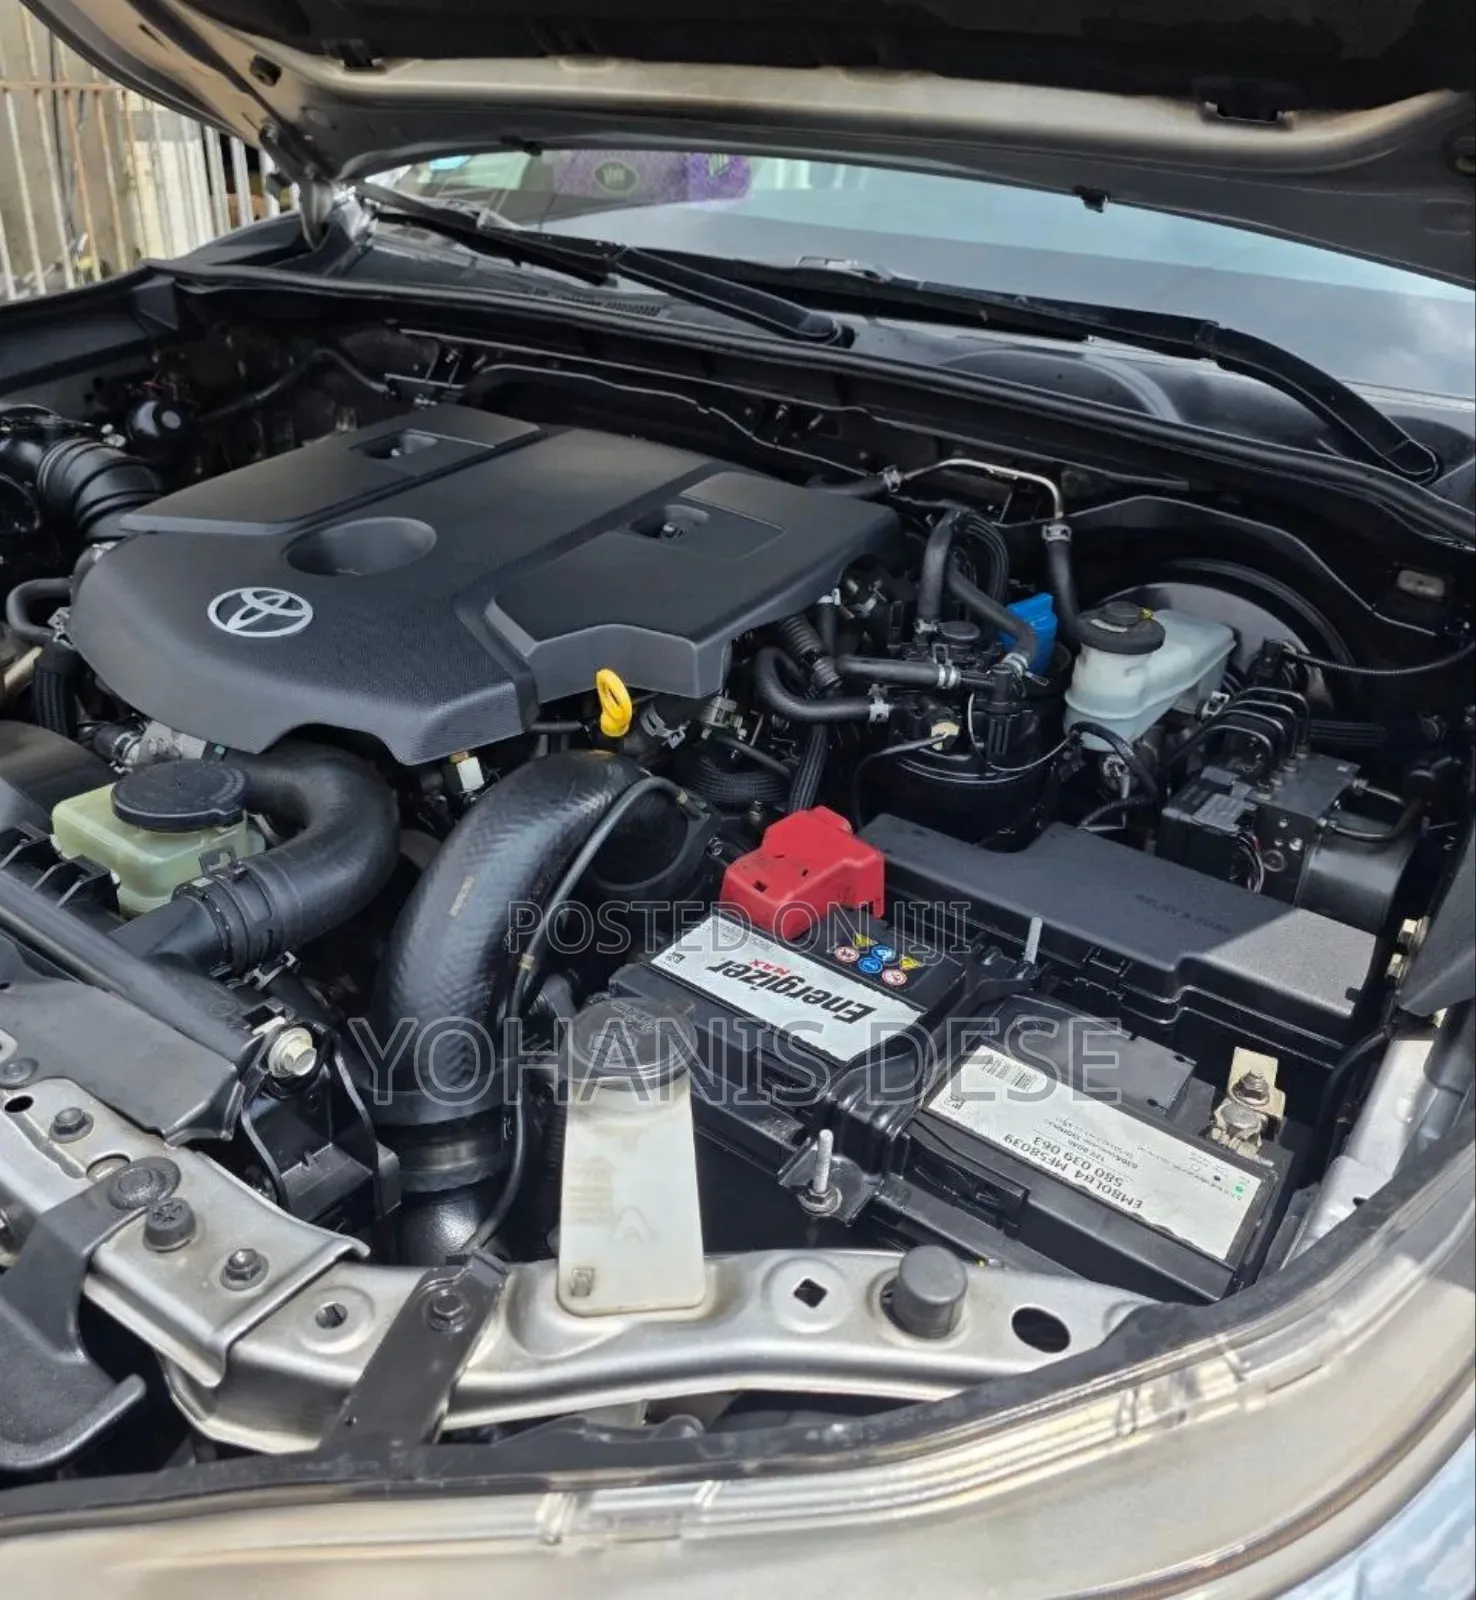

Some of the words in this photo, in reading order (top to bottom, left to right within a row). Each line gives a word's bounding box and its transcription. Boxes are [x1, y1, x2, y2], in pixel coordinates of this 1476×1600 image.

[706, 959, 877, 1025] Energizer
[1003, 1133, 1069, 1172] MF58039
[1033, 1136, 1062, 1155] 063
[1063, 1151, 1092, 1172] 039
[1094, 1167, 1124, 1188] 580
